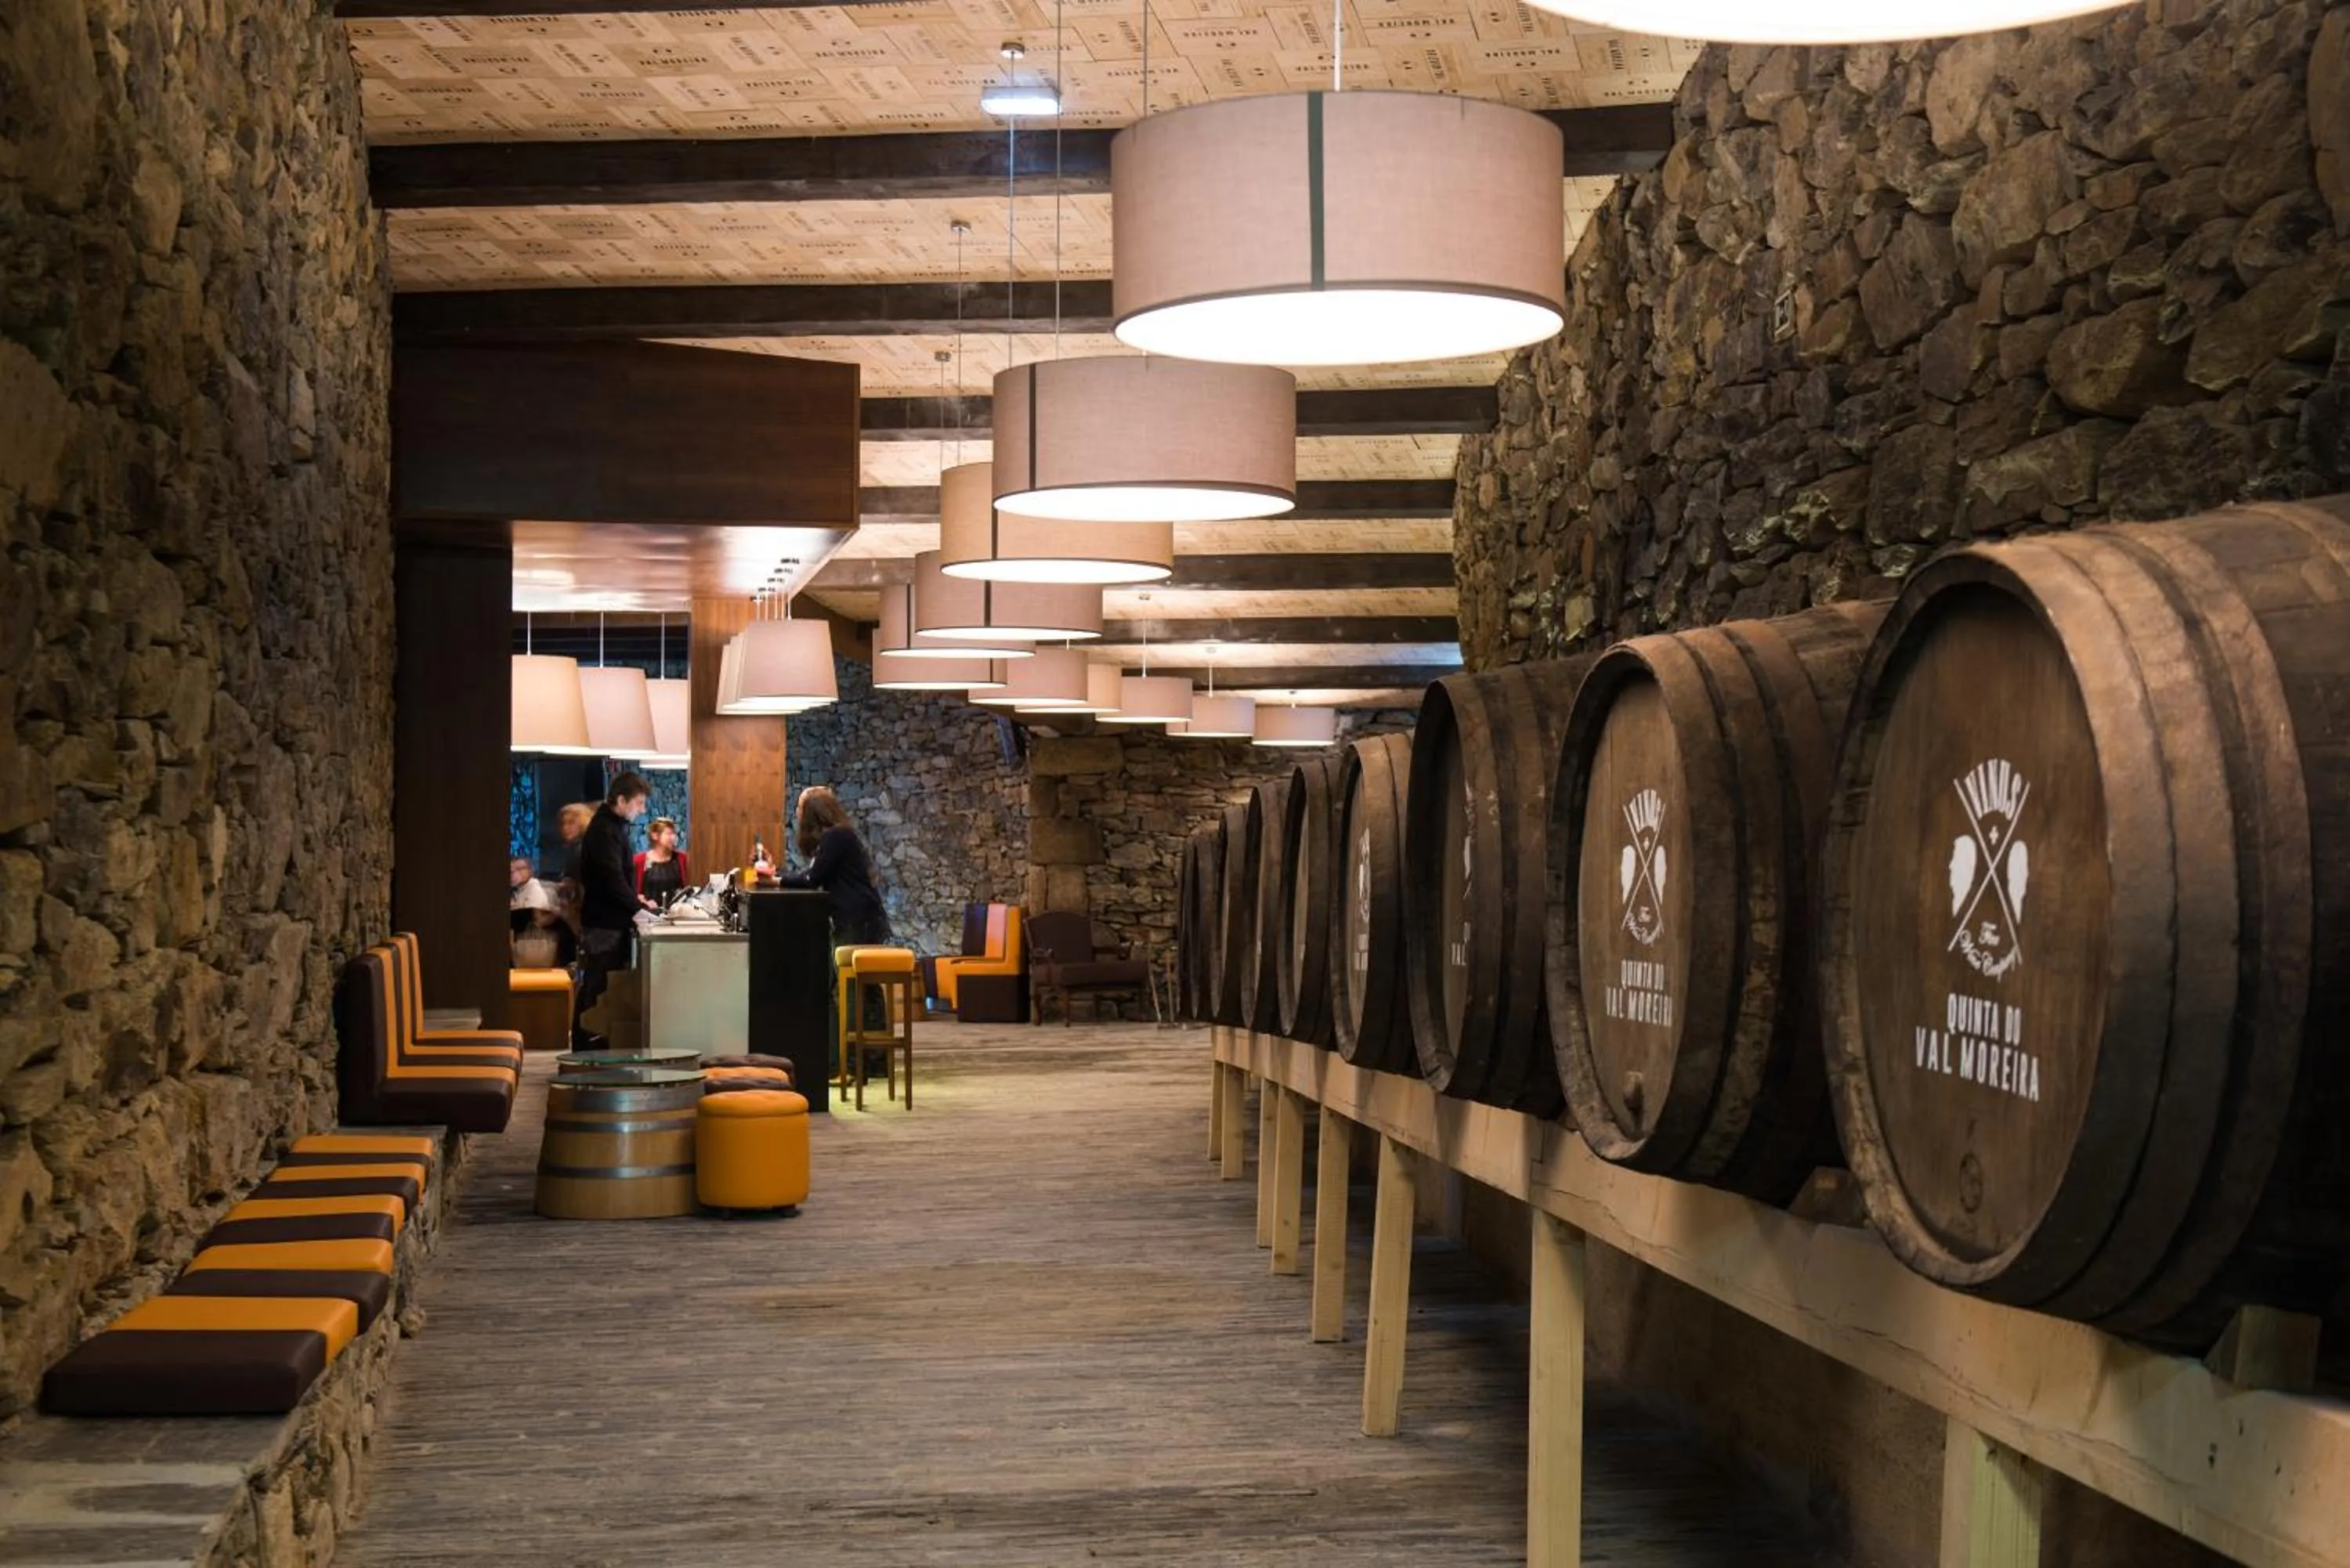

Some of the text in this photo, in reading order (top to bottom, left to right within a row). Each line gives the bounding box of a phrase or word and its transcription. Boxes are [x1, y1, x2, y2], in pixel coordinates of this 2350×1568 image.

[1947, 992, 2021, 1046] QUINTA DO
[1915, 1025, 2039, 1103] VAL MOREIRA
